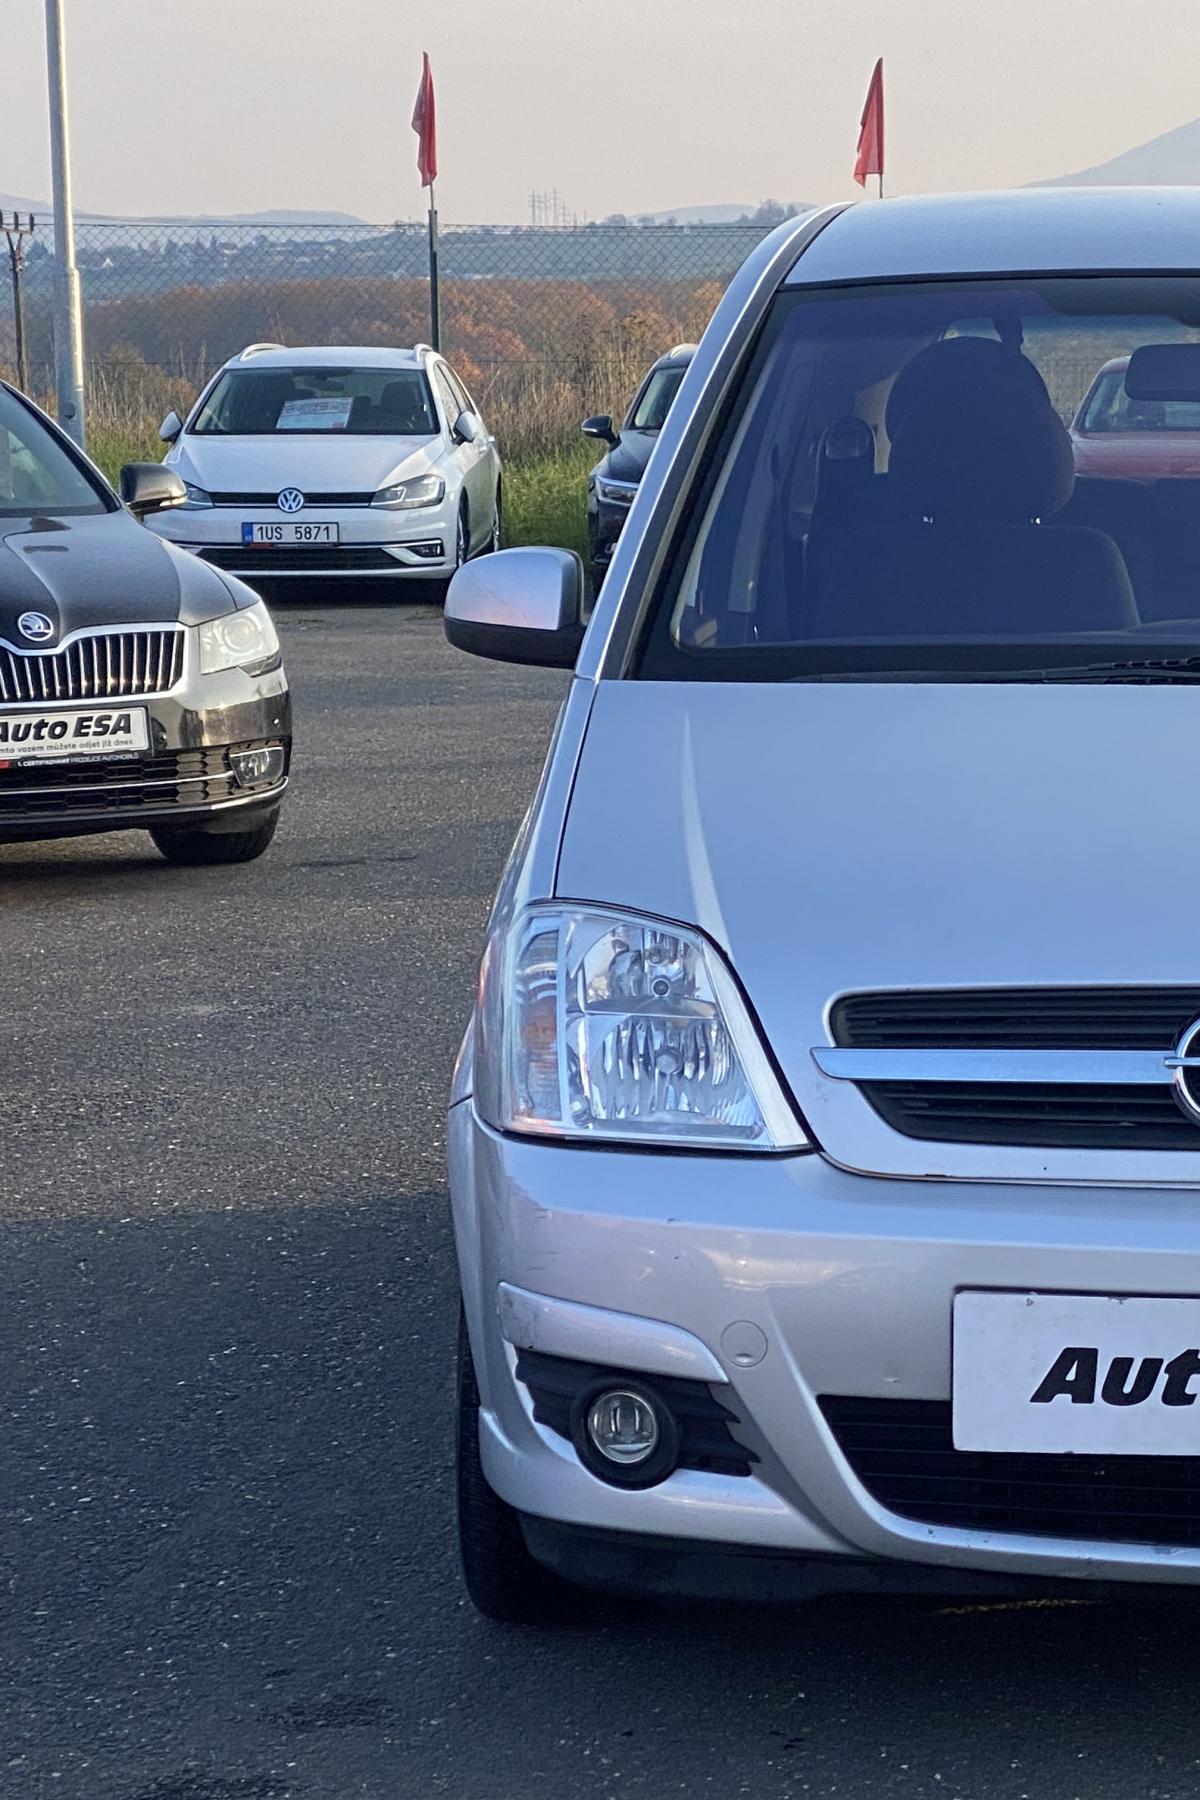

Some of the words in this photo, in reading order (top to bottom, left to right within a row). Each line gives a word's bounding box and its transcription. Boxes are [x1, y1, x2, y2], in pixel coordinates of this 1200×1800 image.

[257, 526, 283, 540] 1US
[294, 526, 330, 540] 5871
[73, 713, 131, 738] ESA
[79, 740, 100, 750] odjet
